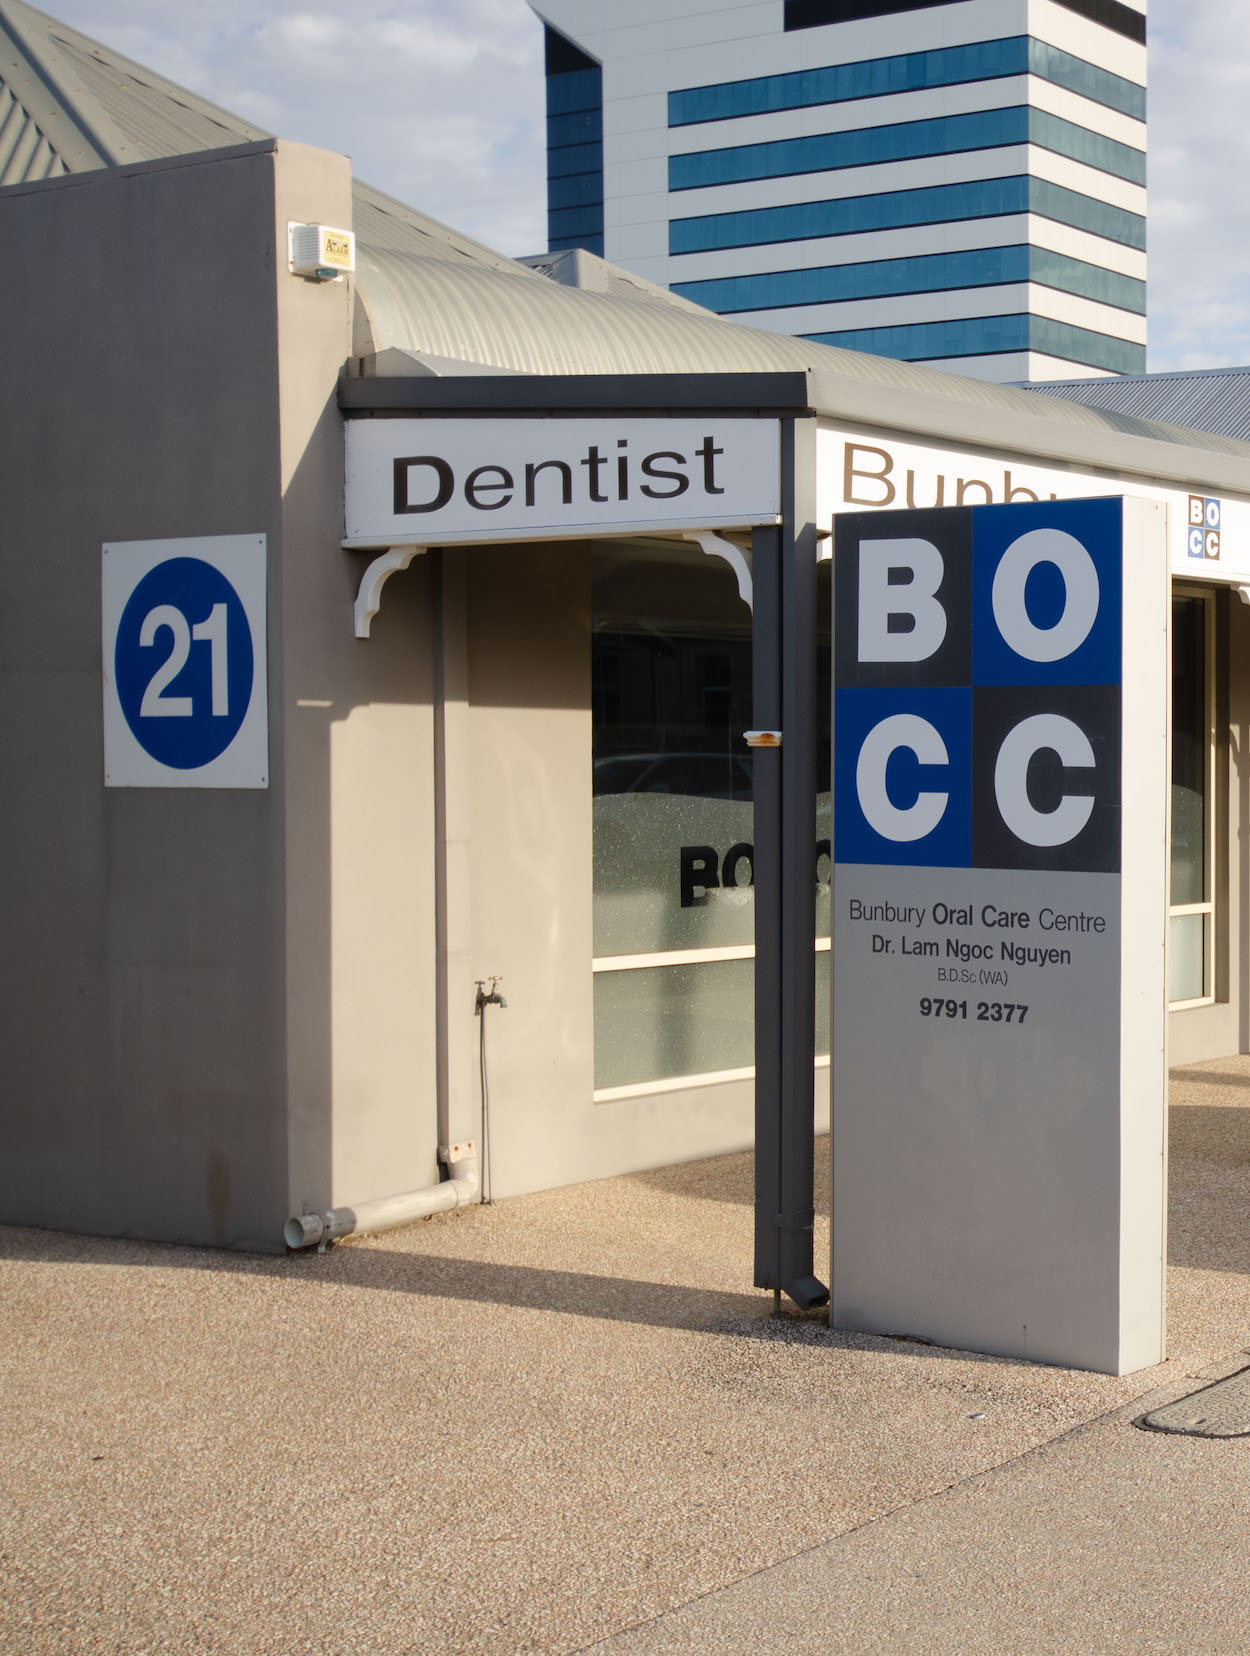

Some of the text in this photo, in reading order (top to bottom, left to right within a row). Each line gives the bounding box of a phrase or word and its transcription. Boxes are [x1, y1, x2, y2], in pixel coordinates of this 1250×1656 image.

[393, 436, 725, 515] Dentist
[139, 603, 229, 717] 21
[850, 899, 1106, 933] Bunbury Oral Care Centre
[872, 934, 1071, 967] Dr. Lam Ngoc Nguyen
[979, 970, 1008, 986] (WA)
[919, 997, 1029, 1024] 9791 2377
